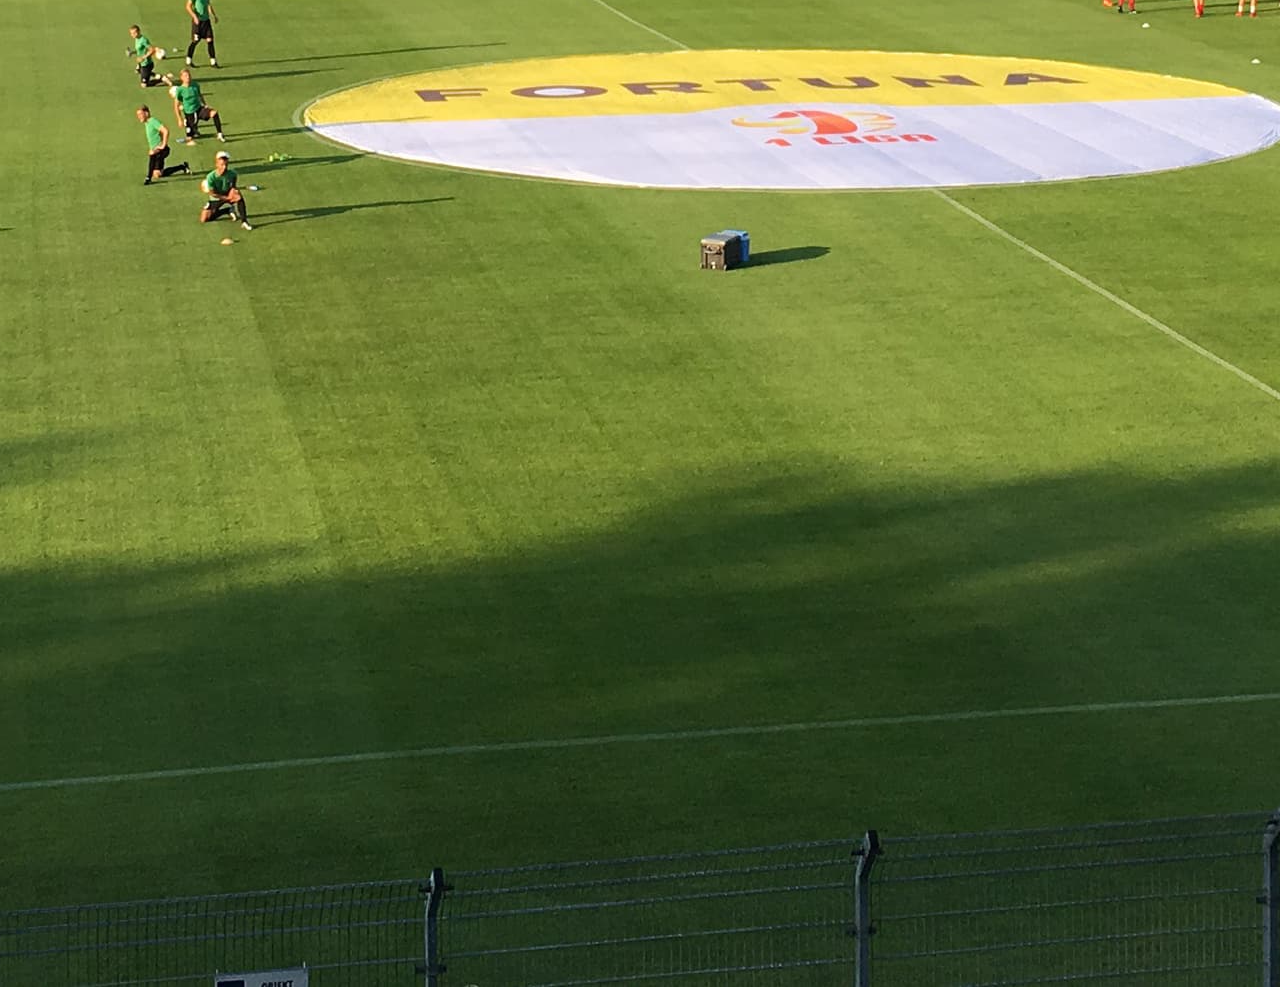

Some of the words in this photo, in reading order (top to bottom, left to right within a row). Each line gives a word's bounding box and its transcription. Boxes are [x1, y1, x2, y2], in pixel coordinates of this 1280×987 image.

[413, 72, 1089, 103] FORTUNA
[764, 138, 793, 148] 1
[812, 133, 939, 147] LIGA
